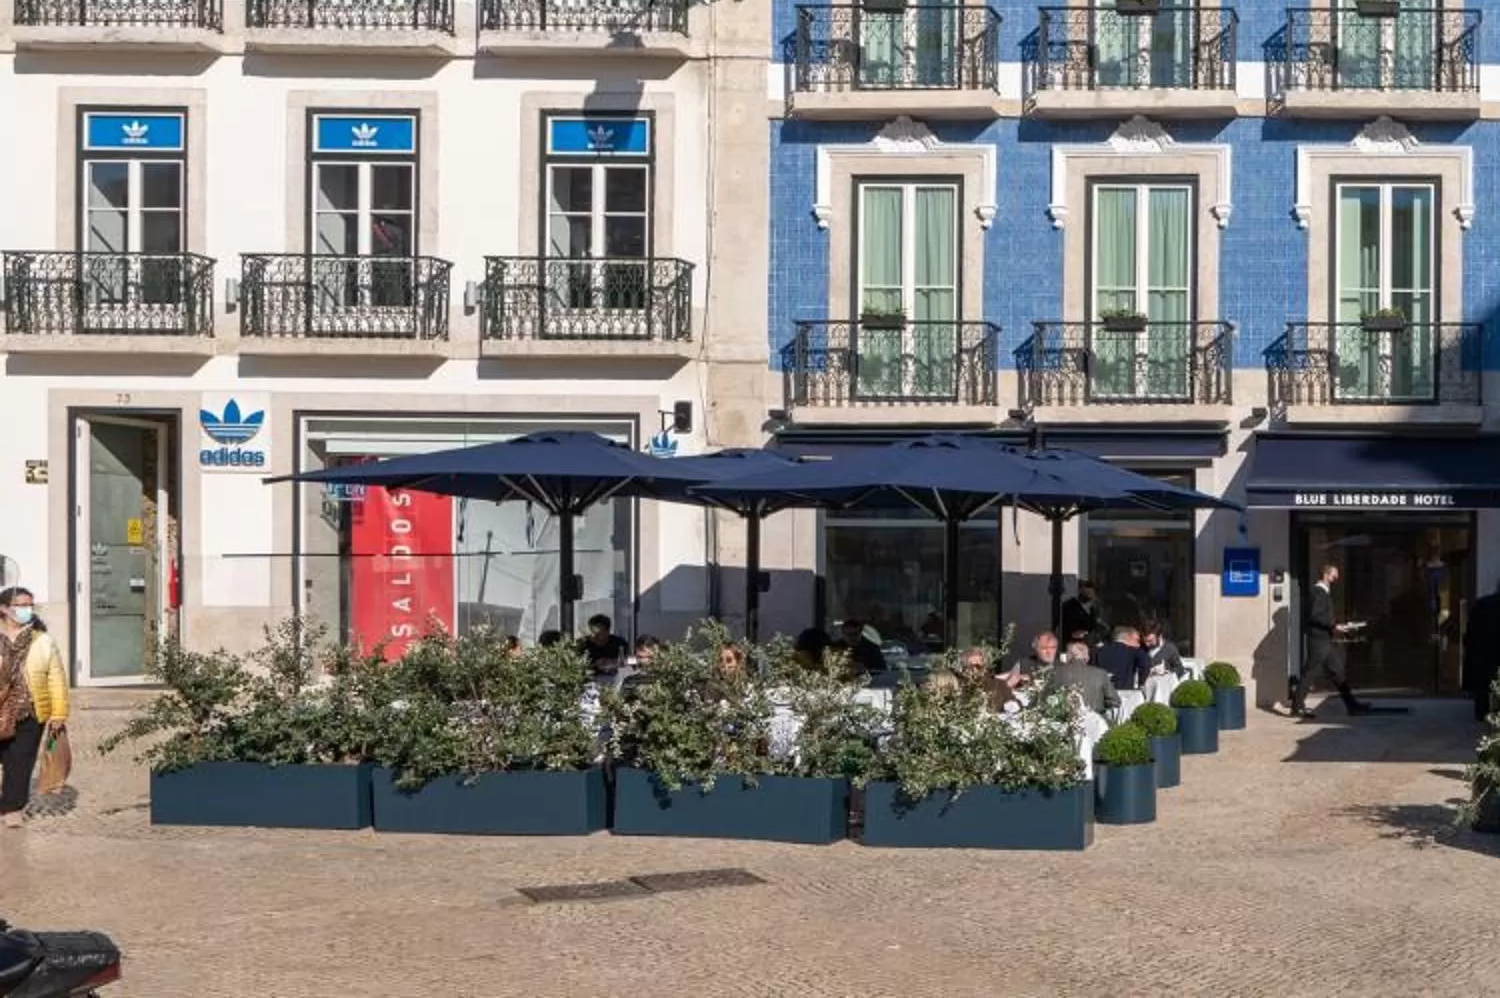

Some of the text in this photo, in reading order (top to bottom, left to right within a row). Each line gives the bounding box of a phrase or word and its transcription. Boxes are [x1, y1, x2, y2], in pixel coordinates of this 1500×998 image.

[199, 448, 264, 467] adidas
[1295, 494, 1455, 506] BLUE LIBERDADE HOTEL
[391, 493, 412, 637] SALDOS
